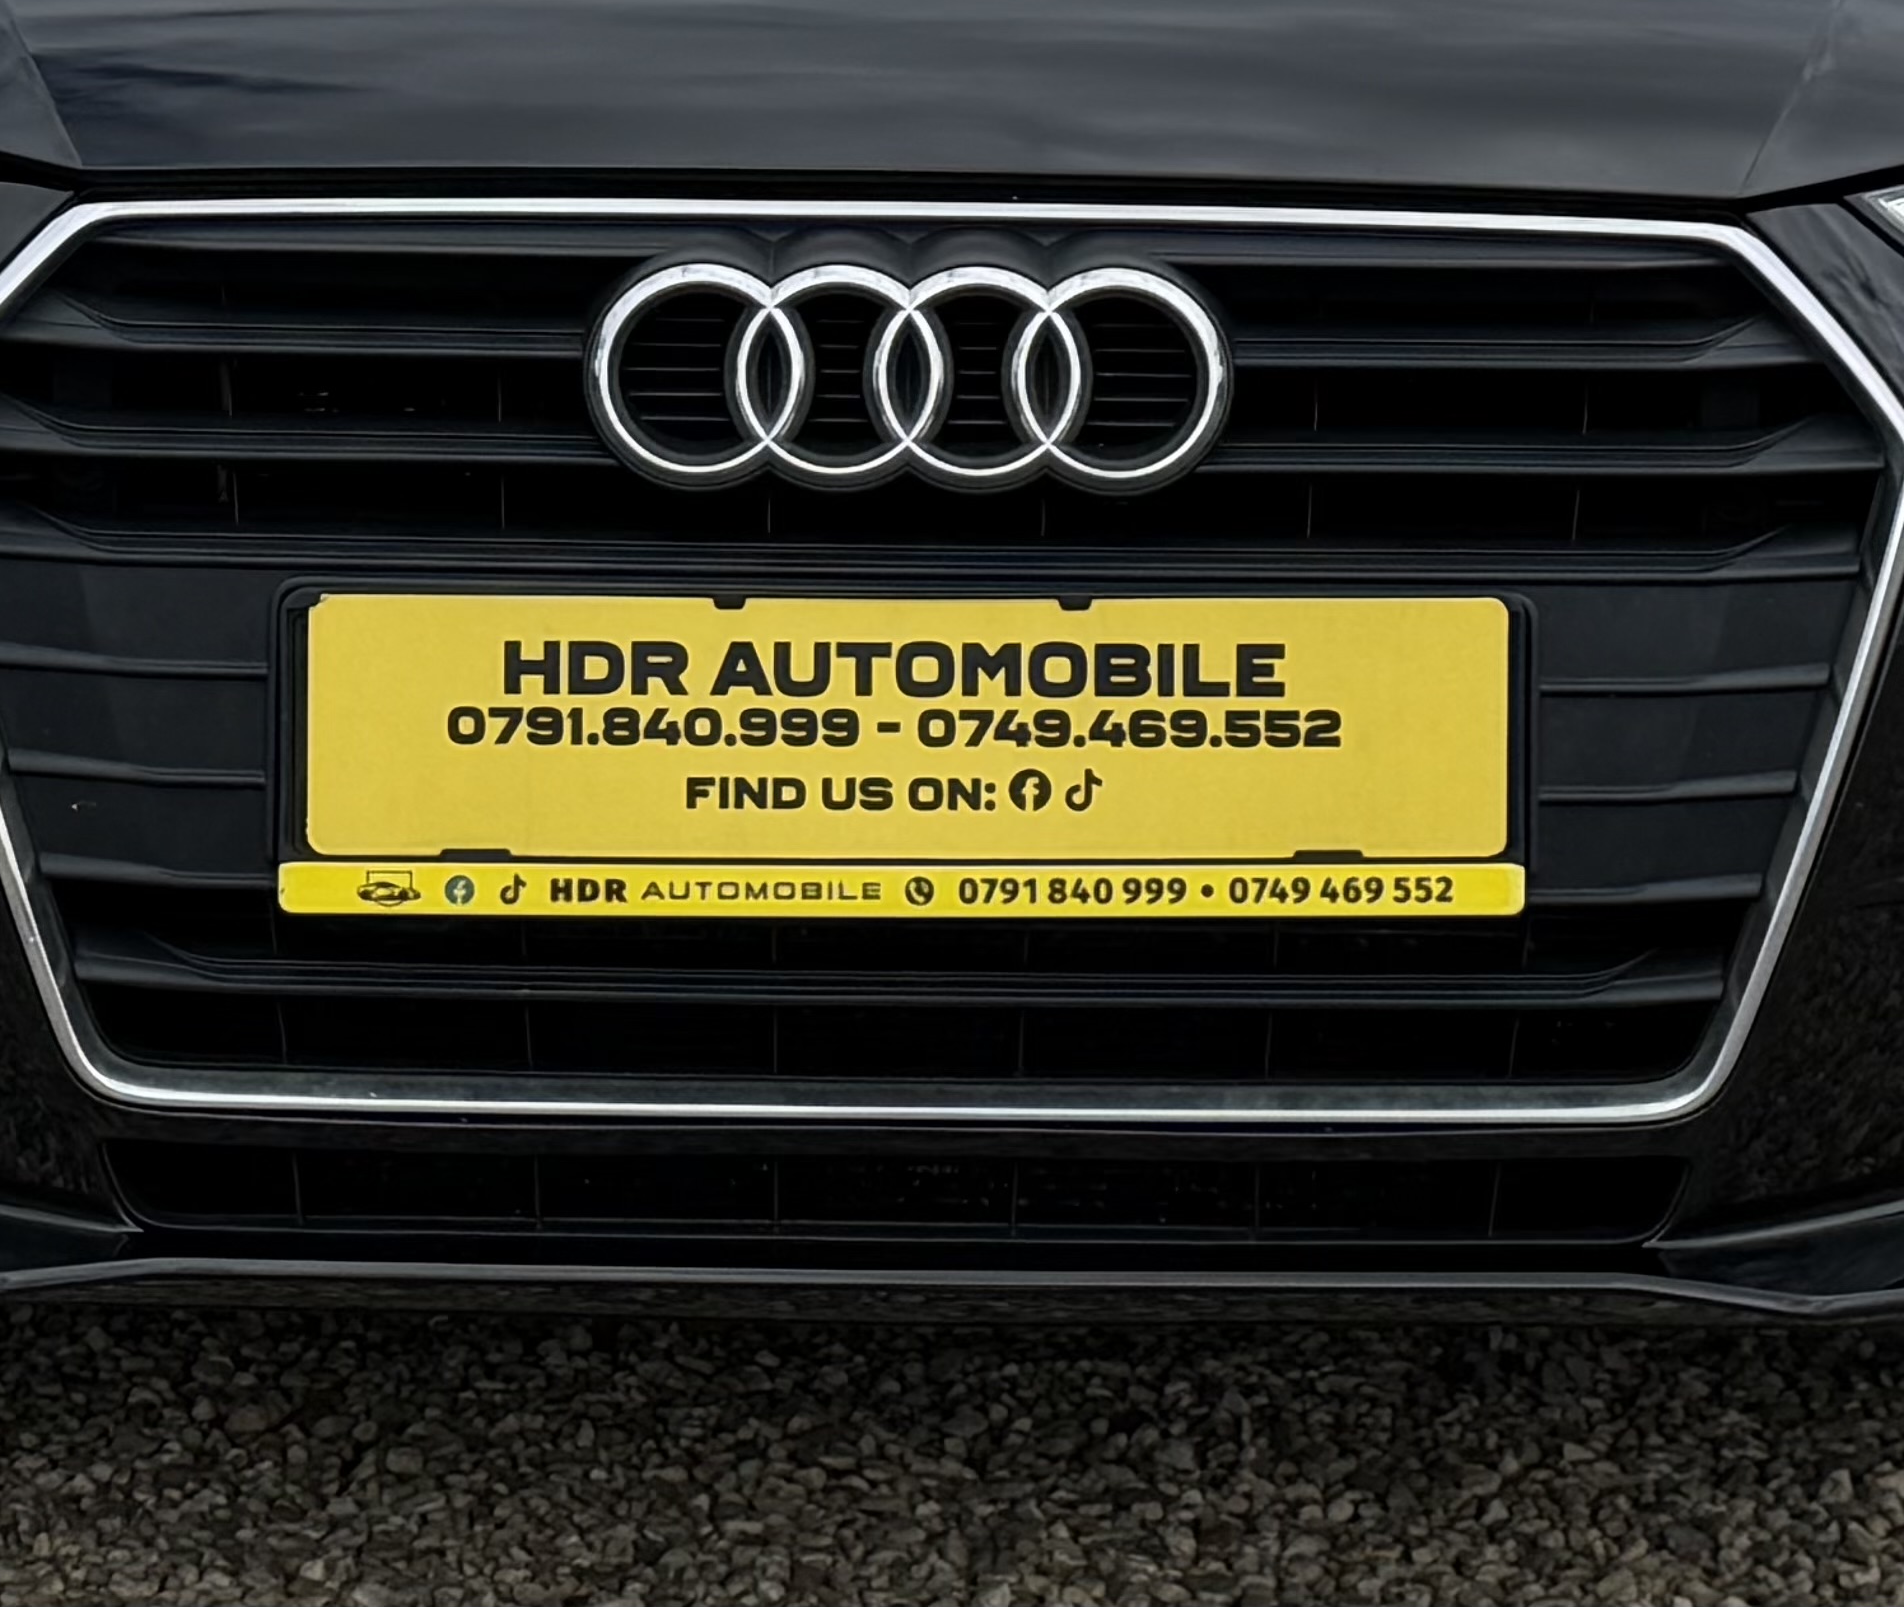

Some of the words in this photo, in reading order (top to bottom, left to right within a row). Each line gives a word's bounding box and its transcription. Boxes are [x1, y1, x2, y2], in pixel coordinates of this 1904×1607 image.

[503, 640, 689, 697] HDR
[709, 640, 1287, 698] AUTOMOBILE
[446, 706, 859, 749] 0791.840.999
[917, 707, 1342, 749] 0749.469.552
[686, 776, 807, 810] FIND
[821, 777, 894, 811] US
[908, 777, 996, 811] ON:
[550, 878, 627, 903] HDR
[641, 881, 882, 901] AUTOMOBILE
[958, 877, 1037, 905] 0791
[1047, 877, 1113, 905] 840
[1122, 877, 1187, 905] 999
[1229, 876, 1311, 904] 0749
[1319, 876, 1384, 904] 469
[1393, 876, 1454, 904] 552
